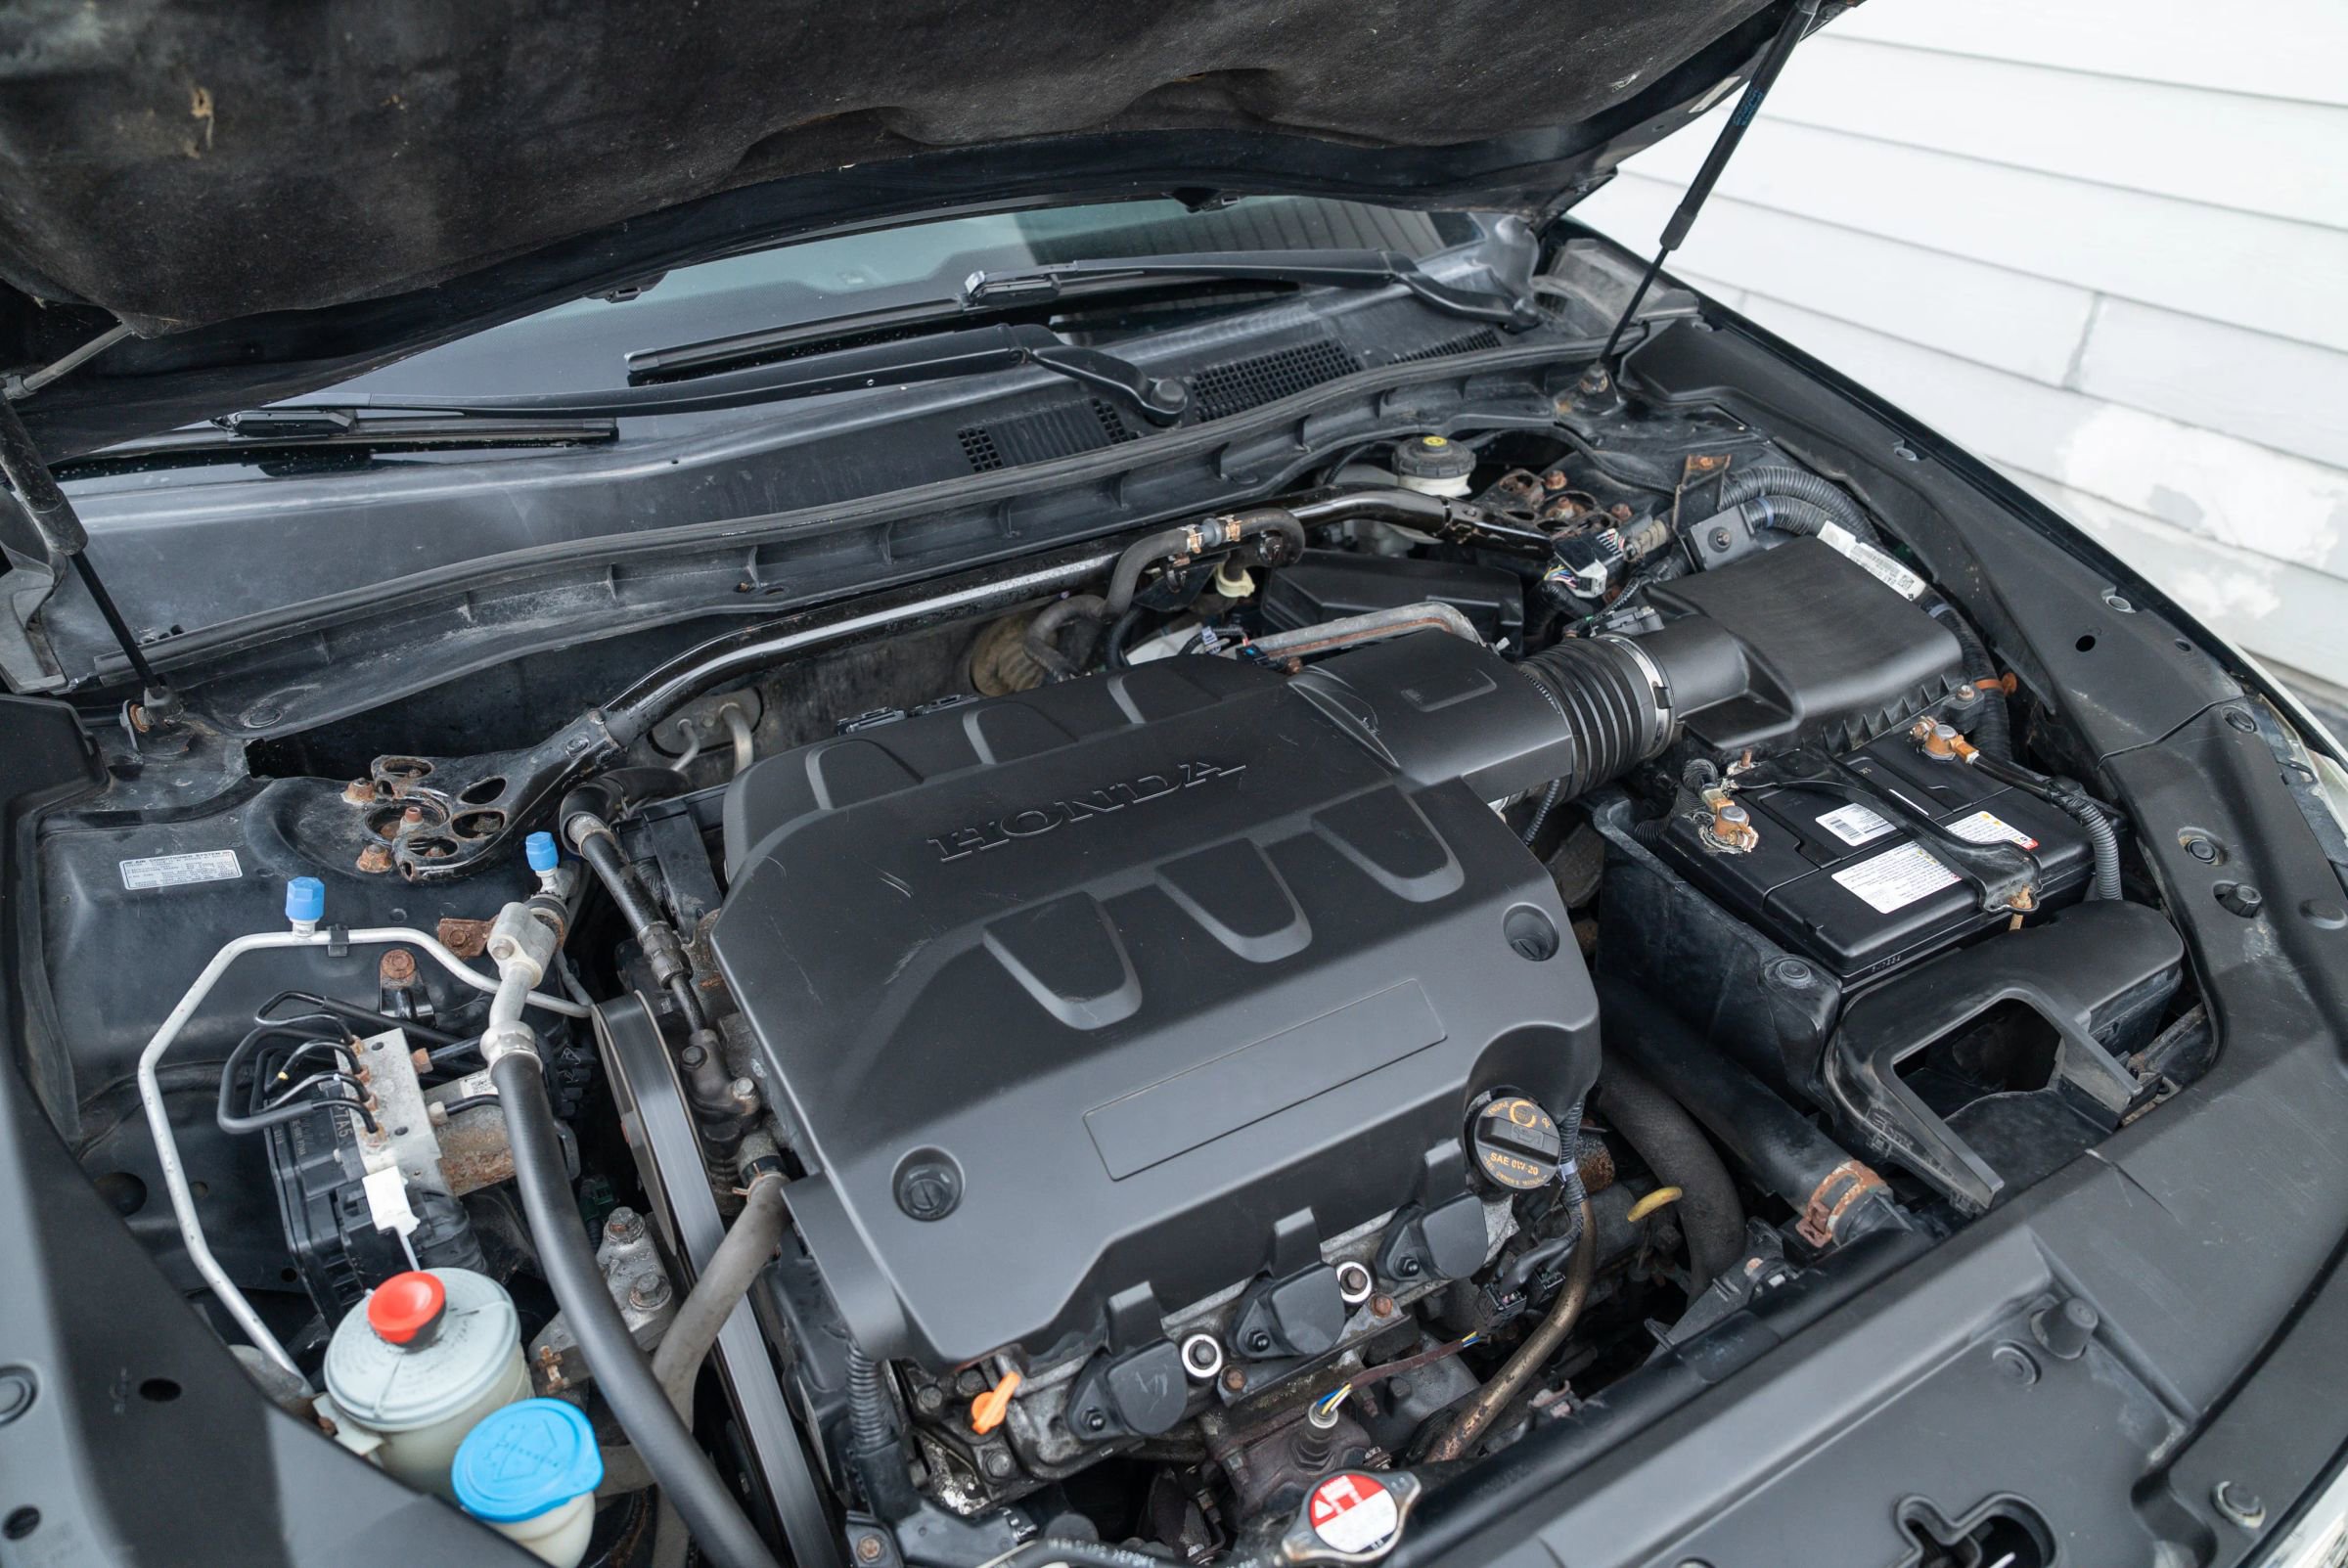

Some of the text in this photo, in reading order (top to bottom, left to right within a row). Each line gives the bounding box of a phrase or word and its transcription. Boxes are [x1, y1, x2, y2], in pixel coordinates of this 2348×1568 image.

[926, 761, 1247, 863] HONDA
[1490, 1152, 1539, 1176] SAE 0W-20
